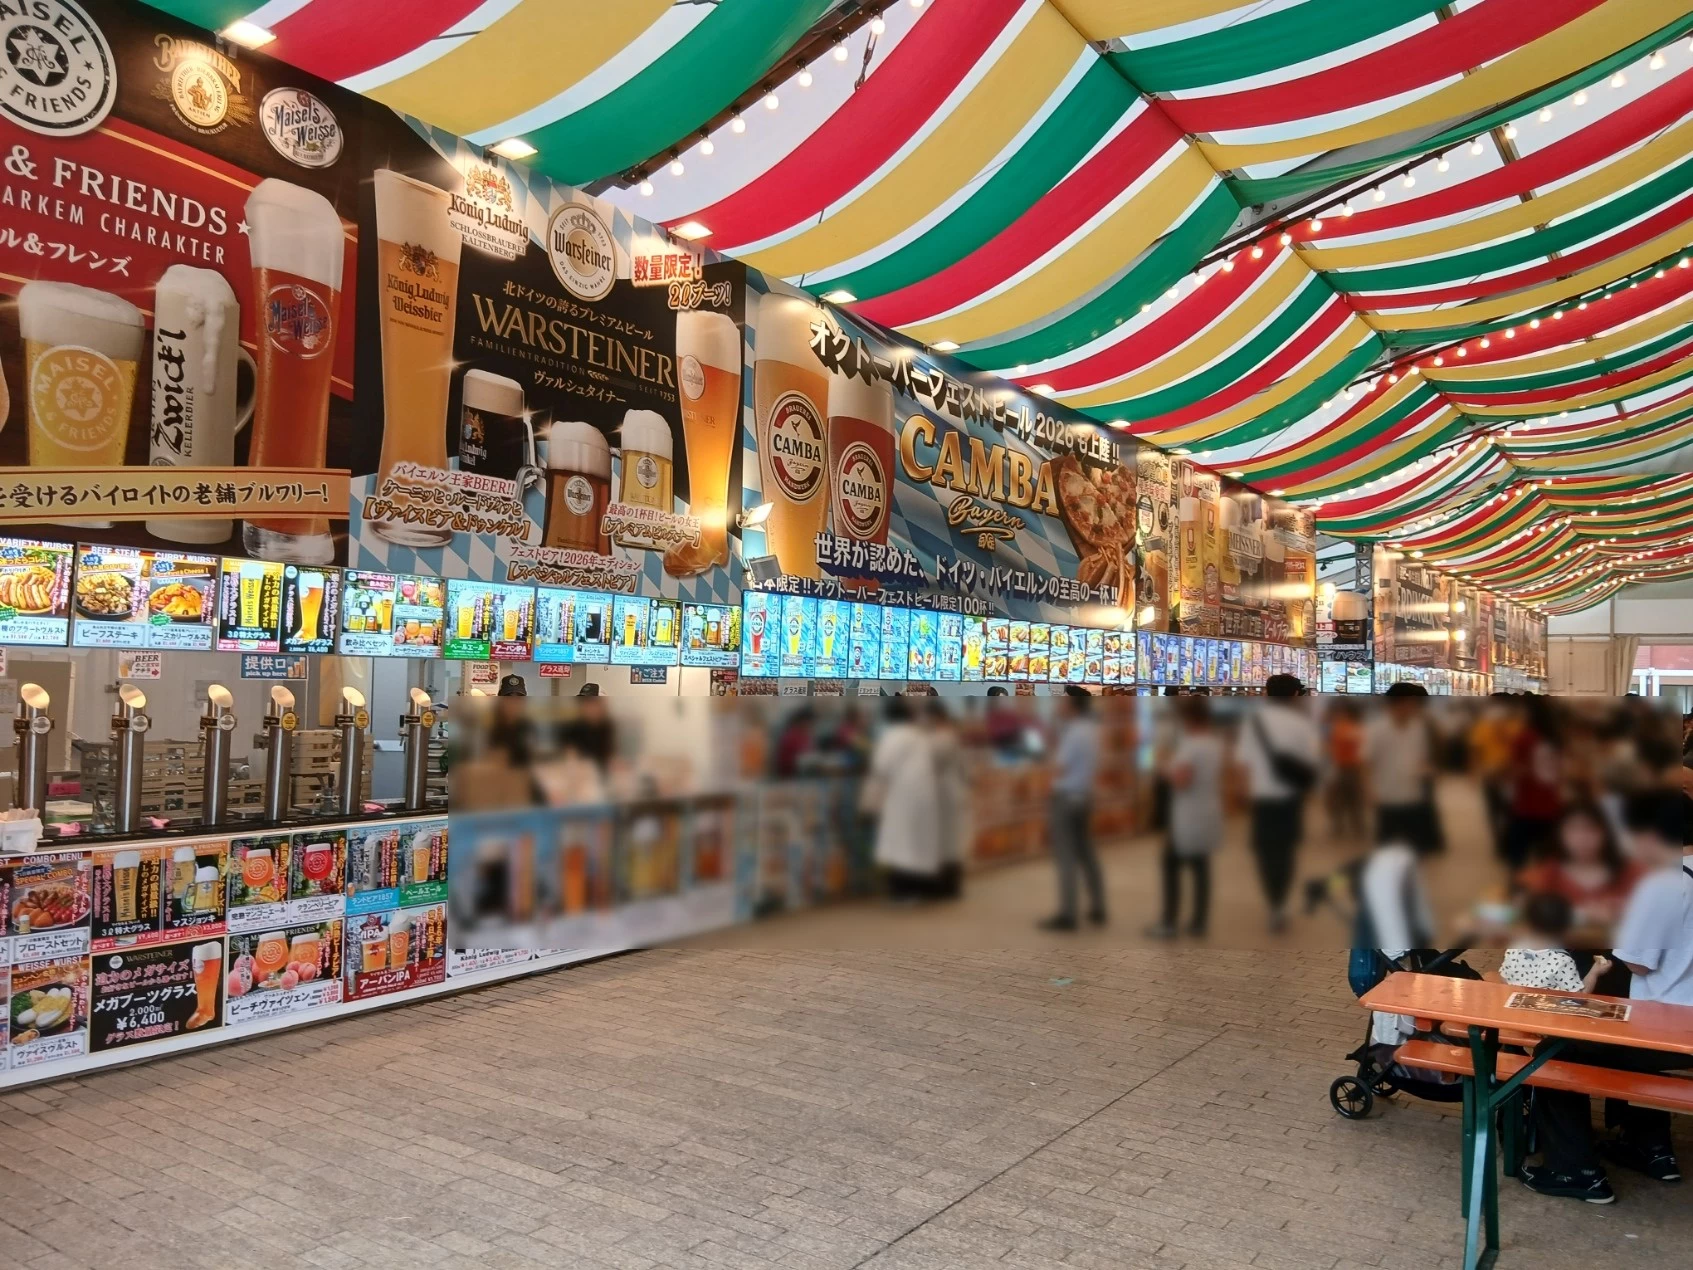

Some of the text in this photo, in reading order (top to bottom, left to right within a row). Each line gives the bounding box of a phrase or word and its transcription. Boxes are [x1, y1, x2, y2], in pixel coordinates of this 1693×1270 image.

[10, 75, 92, 113] FRIENDS
[291, 121, 336, 147] Weisse
[4, 144, 228, 236] & FRIENDS
[3, 185, 225, 265] ARKEM CHARAKTER
[447, 193, 530, 244] König Ludwig
[450, 219, 527, 256] SCHLOSSBRAUEREI
[461, 233, 515, 260] KALTENBERG
[553, 229, 612, 273] Warsteiner
[393, 295, 443, 322] Weissbier
[502, 279, 654, 341] 北ドイツの誇るプレミアムビール
[471, 292, 676, 389] WARSTEINER
[470, 335, 586, 376] FAMILIENTRADITION
[37, 356, 115, 394] MAISEL
[534, 369, 626, 404] ヴァルシュタイナー
[659, 390, 675, 402] 1753
[58, 407, 117, 440] FRIENDS
[183, 386, 195, 457] KELLERBIER
[773, 433, 822, 463] CAMBA
[899, 413, 1060, 518] CAMBA
[395, 464, 515, 496] バイエルン王家BEER!!
[842, 479, 881, 503] CAMBA
[609, 503, 700, 529] 最高の1杯目!ビールの女王
[948, 494, 1026, 538] Bayern
[42, 541, 74, 550] WURST
[91, 546, 141, 559] BEEF STEAK
[154, 552, 217, 564] CURRY WURST
[510, 546, 641, 571] フェストビア!2026年エディション
[82, 629, 138, 639] ビーフステーキ
[245, 655, 286, 670] 提供口
[643, 668, 666, 679] ご注文
[23, 852, 83, 865] COMBO MENU
[47, 868, 73, 879] COMBO
[172, 914, 216, 926] マスジョッキ
[285, 925, 316, 936] FRIENDS
[17, 955, 83, 972] WEISSE WURST
[126, 949, 174, 963] WARSTEINER
[360, 970, 411, 989] アーバンIPA
[94, 983, 198, 1013] メガブーツグラス
